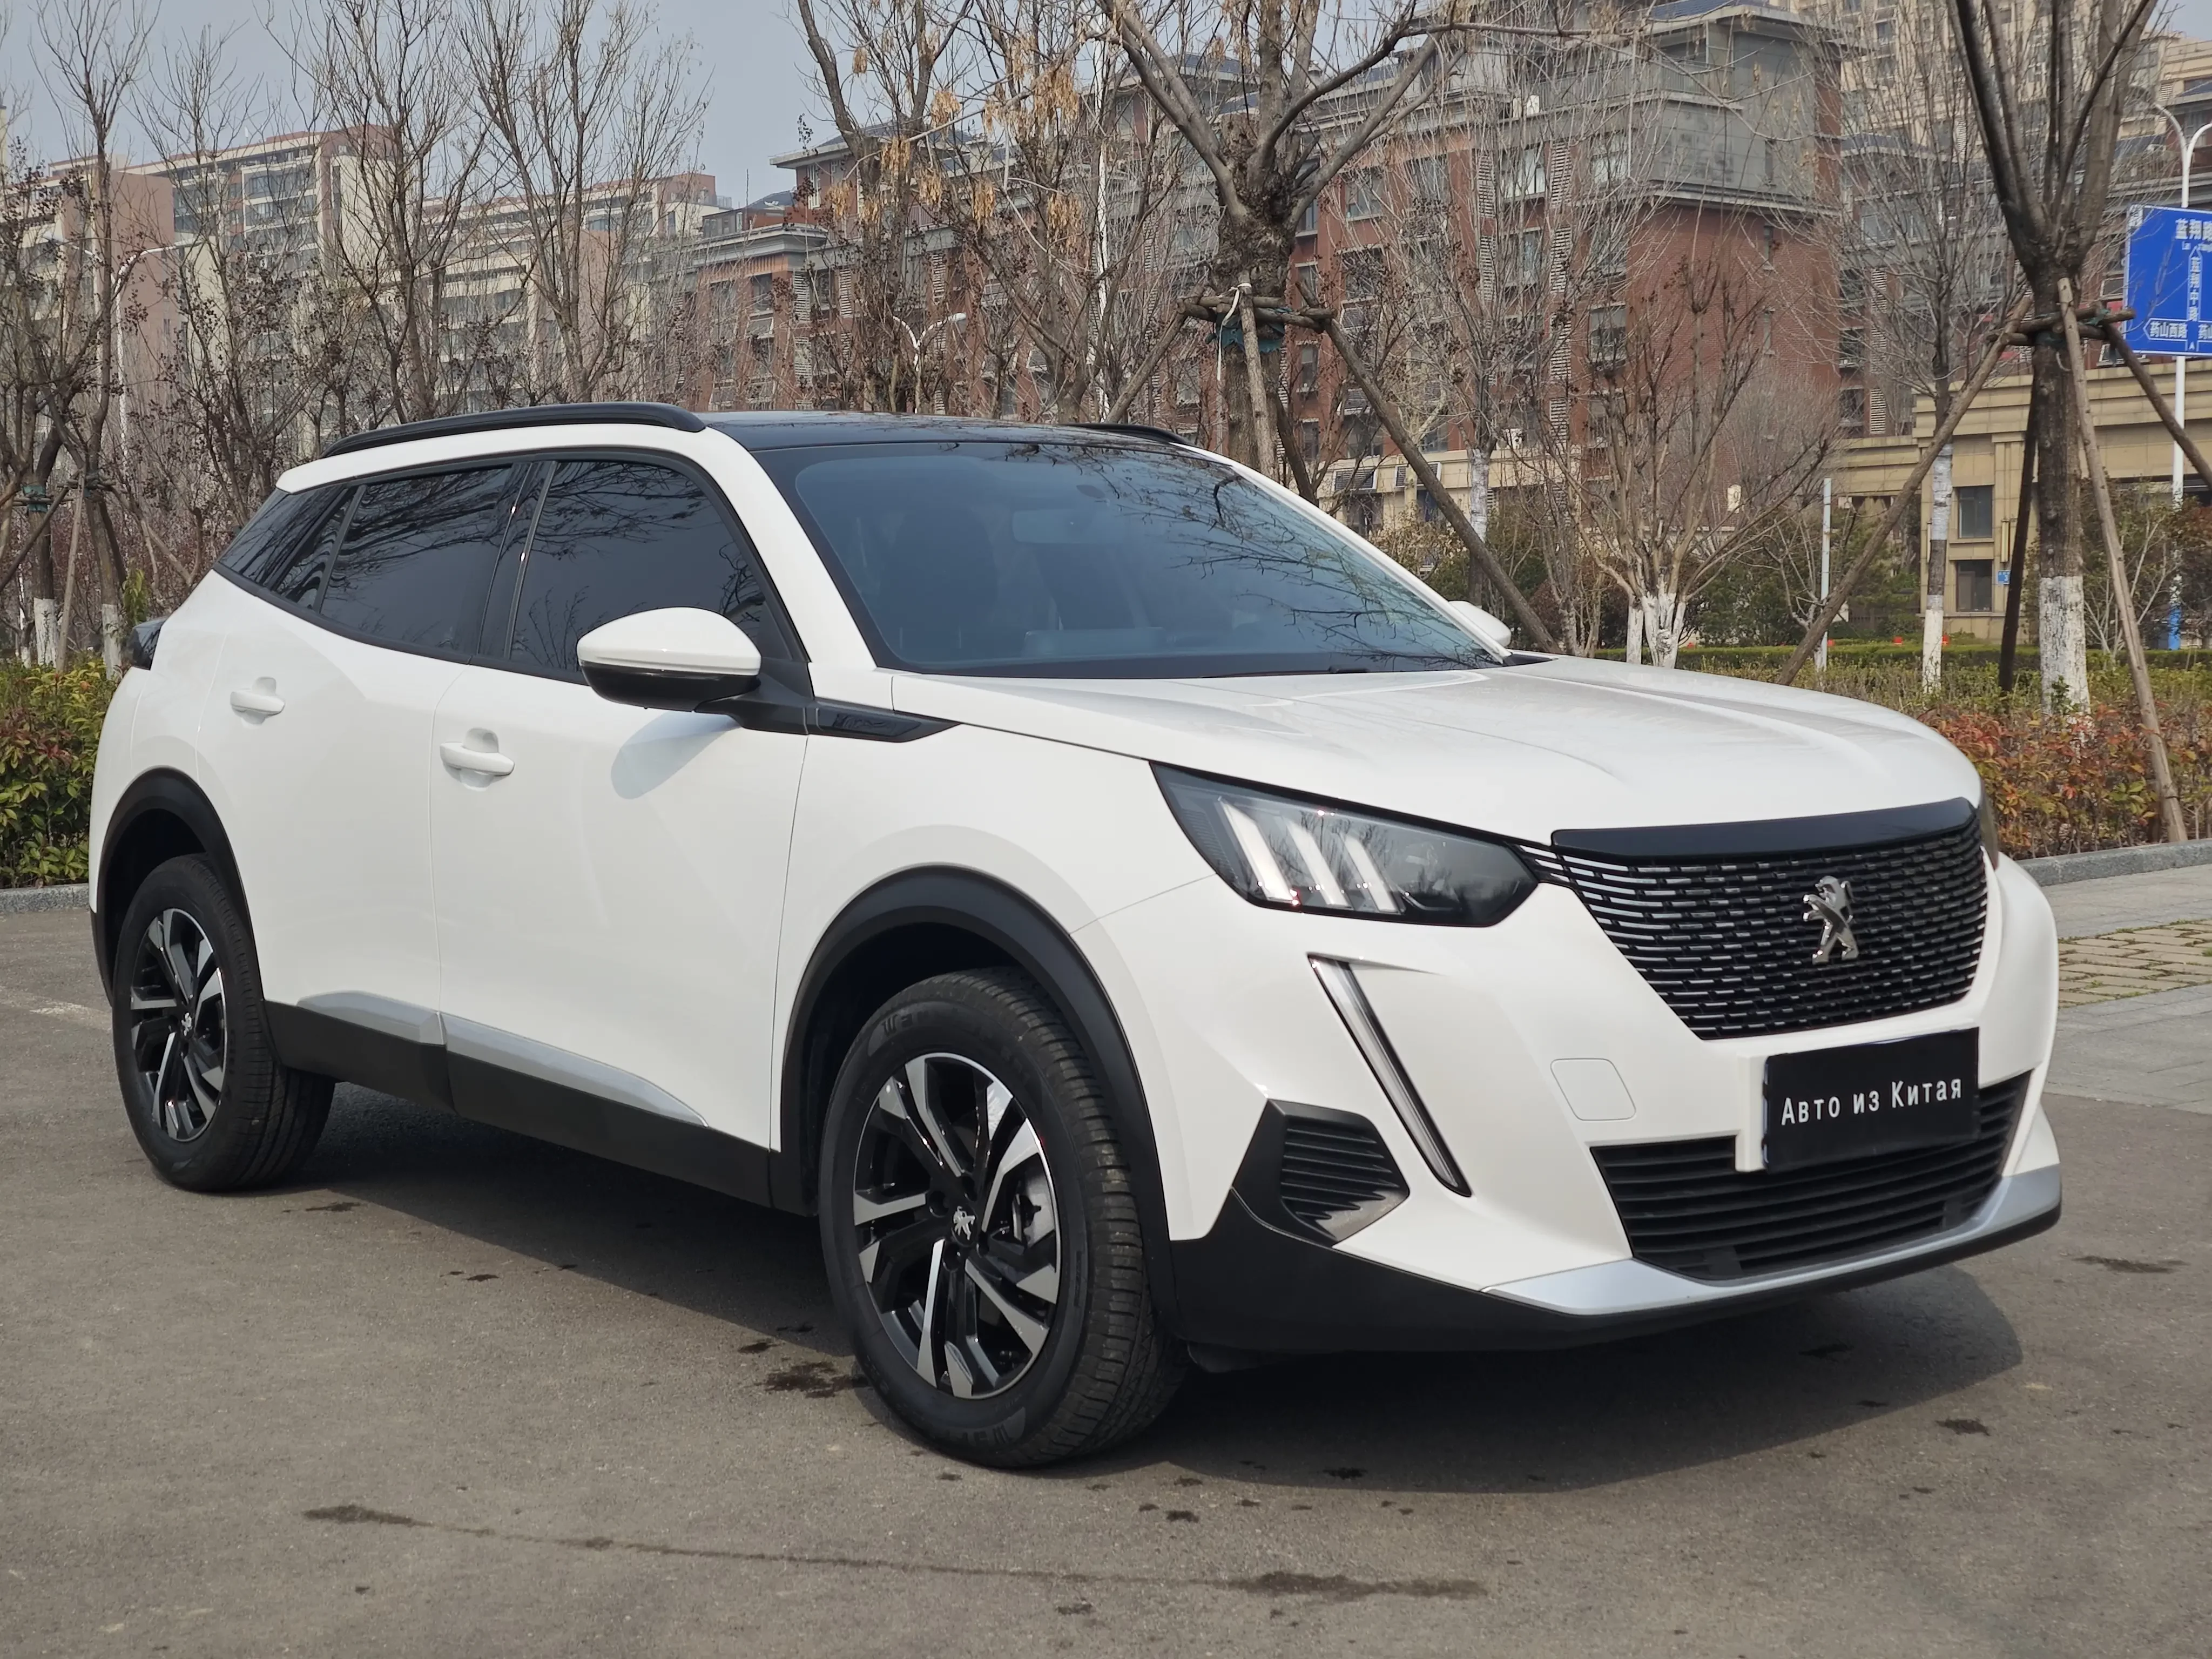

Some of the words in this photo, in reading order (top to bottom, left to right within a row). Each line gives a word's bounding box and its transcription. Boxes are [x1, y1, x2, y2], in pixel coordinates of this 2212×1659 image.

[2150, 321, 2188, 339] 药山西路
[1782, 1096, 1841, 1126] Авто
[1853, 1090, 1880, 1115] из
[1891, 1078, 1962, 1108] Китая
